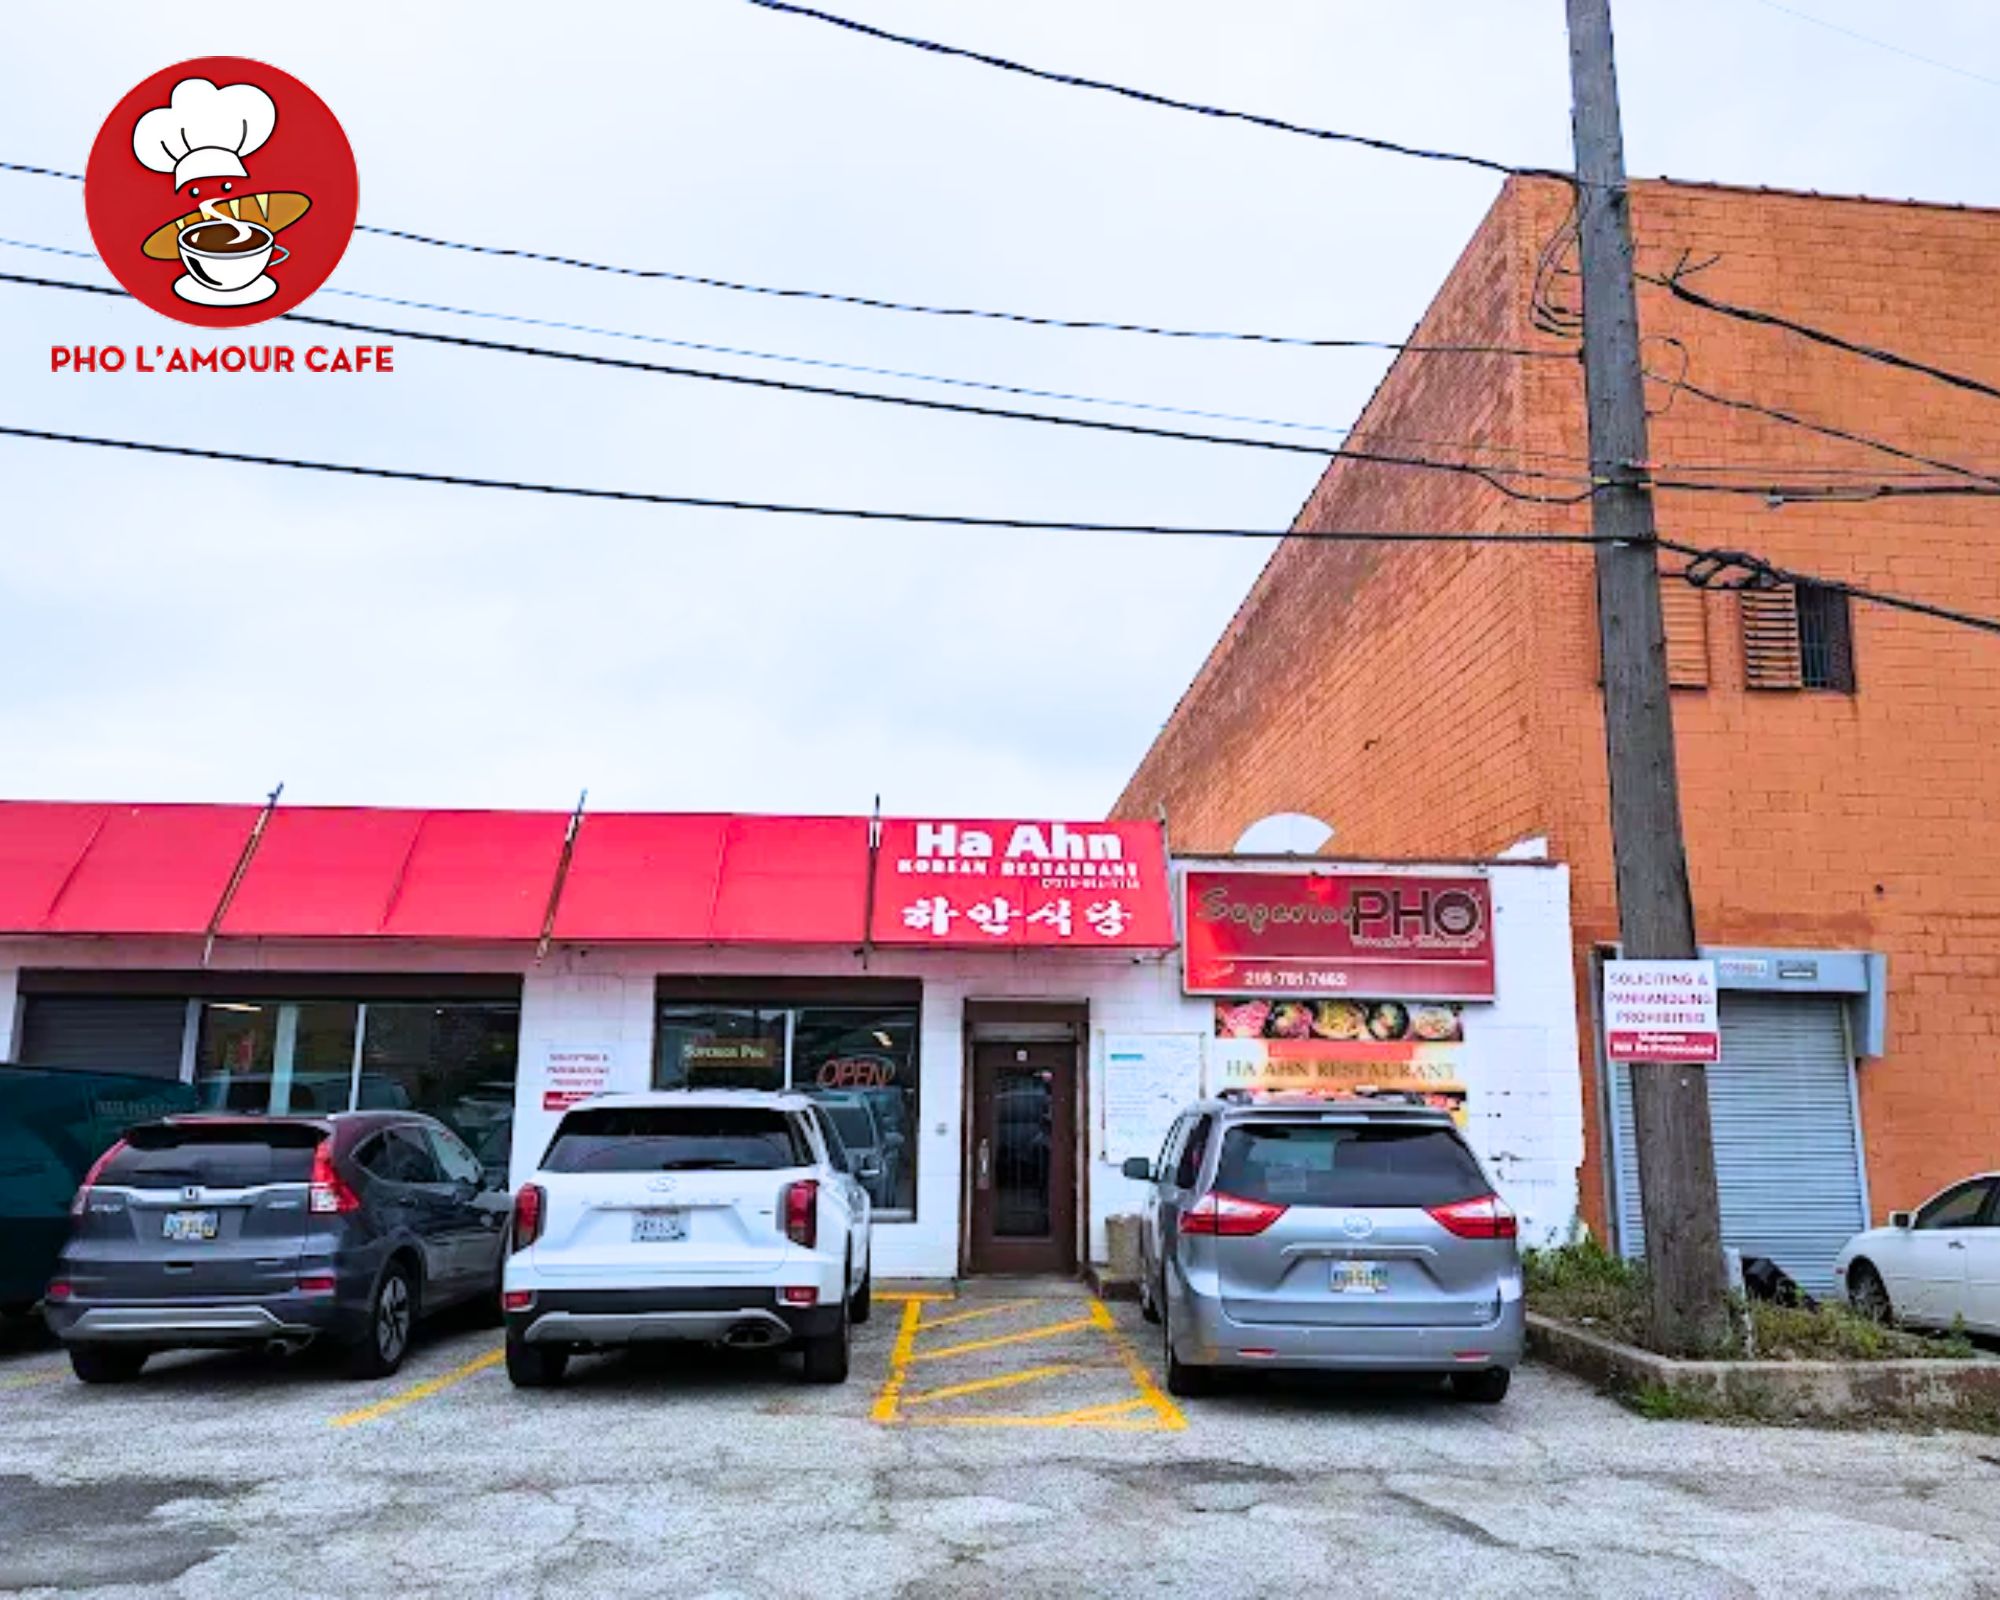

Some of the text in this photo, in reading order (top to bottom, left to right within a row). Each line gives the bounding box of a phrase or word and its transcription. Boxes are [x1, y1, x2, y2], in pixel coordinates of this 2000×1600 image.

[915, 823, 1123, 860] Ha Ahn
[897, 859, 1138, 877] KOREAN RESTAURANT
[1350, 888, 1480, 937] PHO
[817, 1058, 889, 1088] OPEN
[1226, 1060, 1457, 1080] HA AHN RESTAURANT
